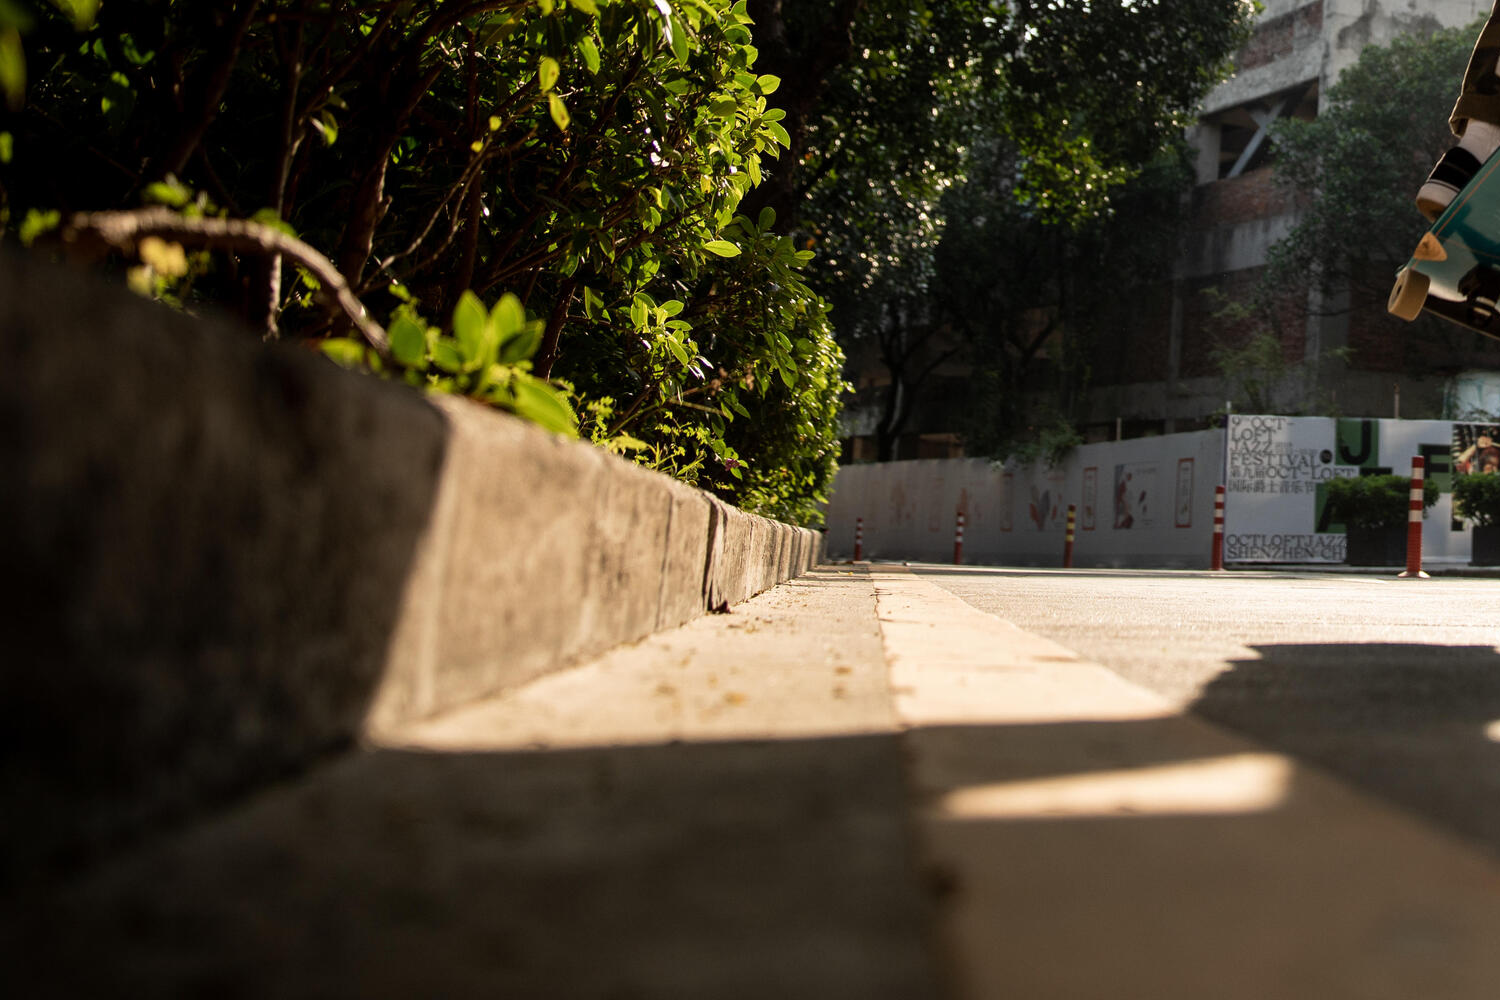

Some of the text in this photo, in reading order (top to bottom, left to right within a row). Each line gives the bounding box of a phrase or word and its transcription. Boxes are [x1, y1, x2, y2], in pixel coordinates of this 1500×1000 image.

[1231, 428, 1274, 442] LOFT
[1230, 441, 1274, 454] JAZZ
[1231, 453, 1318, 467] FESTIVAL
[1226, 547, 1315, 560] SHENZHEN
